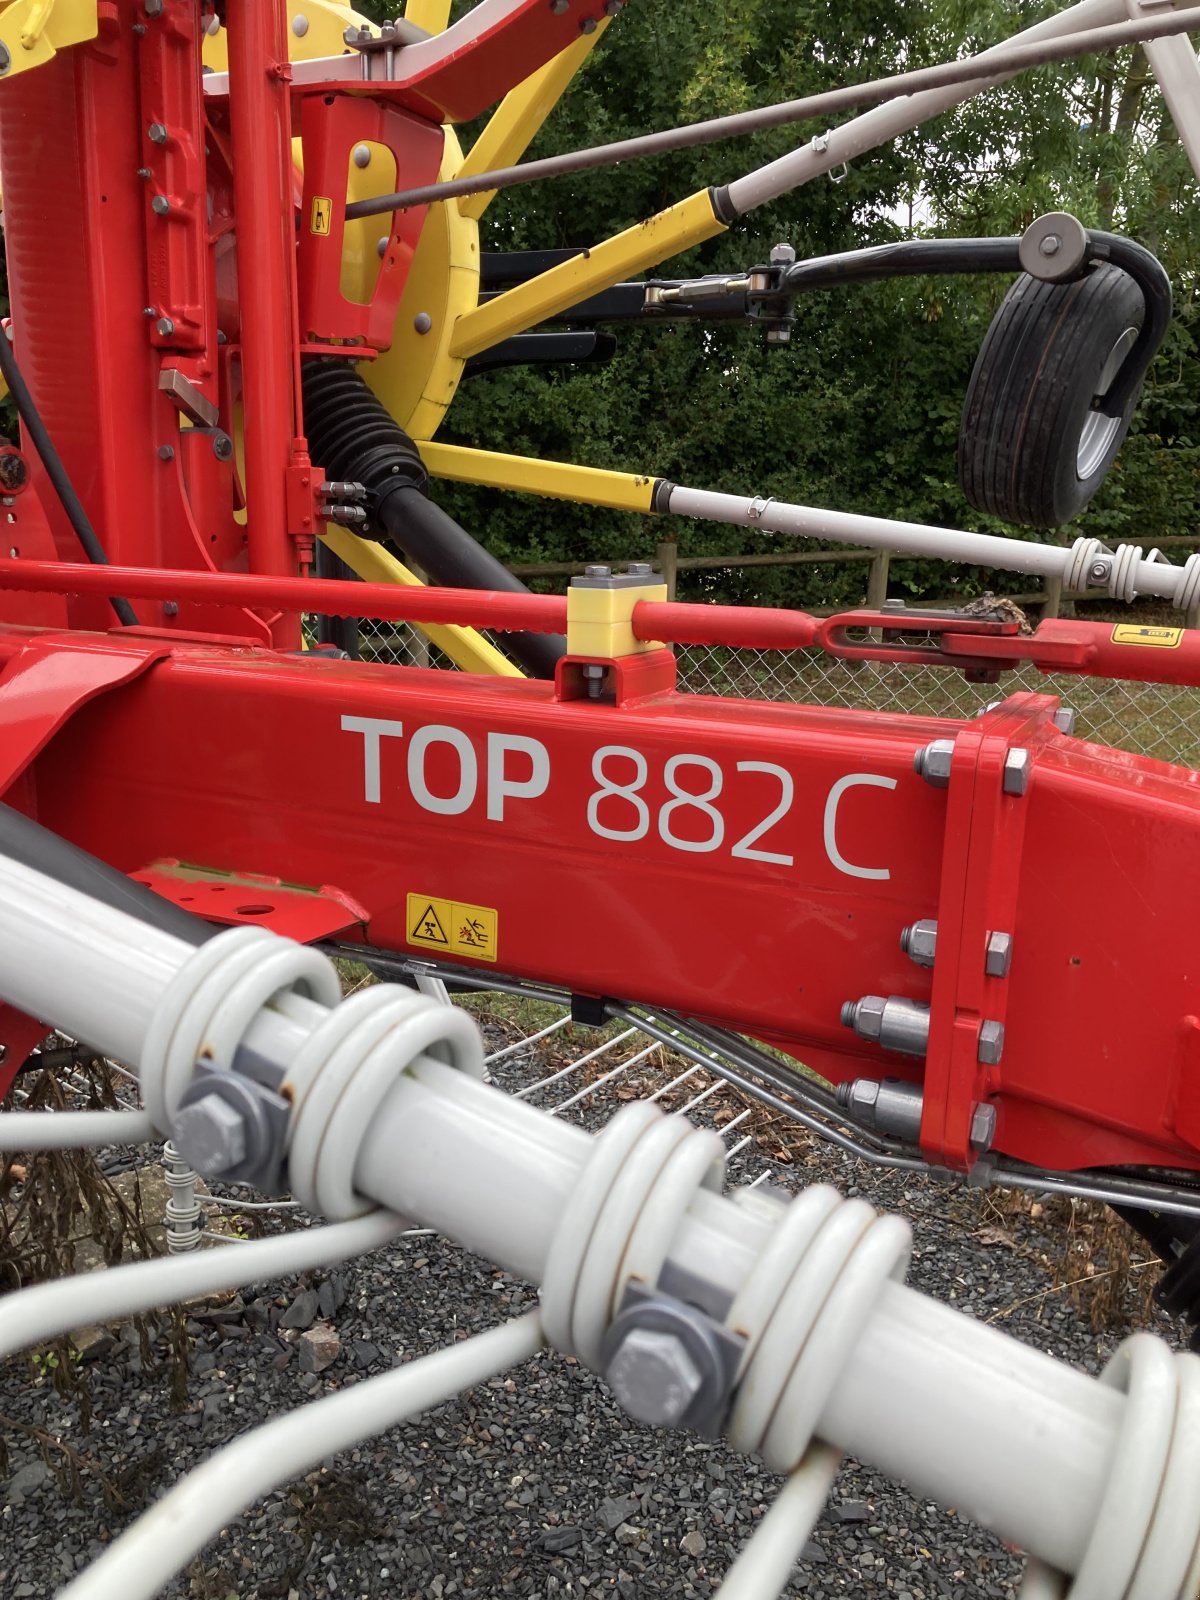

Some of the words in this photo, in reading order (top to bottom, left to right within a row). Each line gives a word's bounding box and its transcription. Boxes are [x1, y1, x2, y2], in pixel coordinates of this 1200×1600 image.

[341, 715, 550, 821] TOP
[587, 745, 794, 866] 882
[823, 773, 898, 880] C
